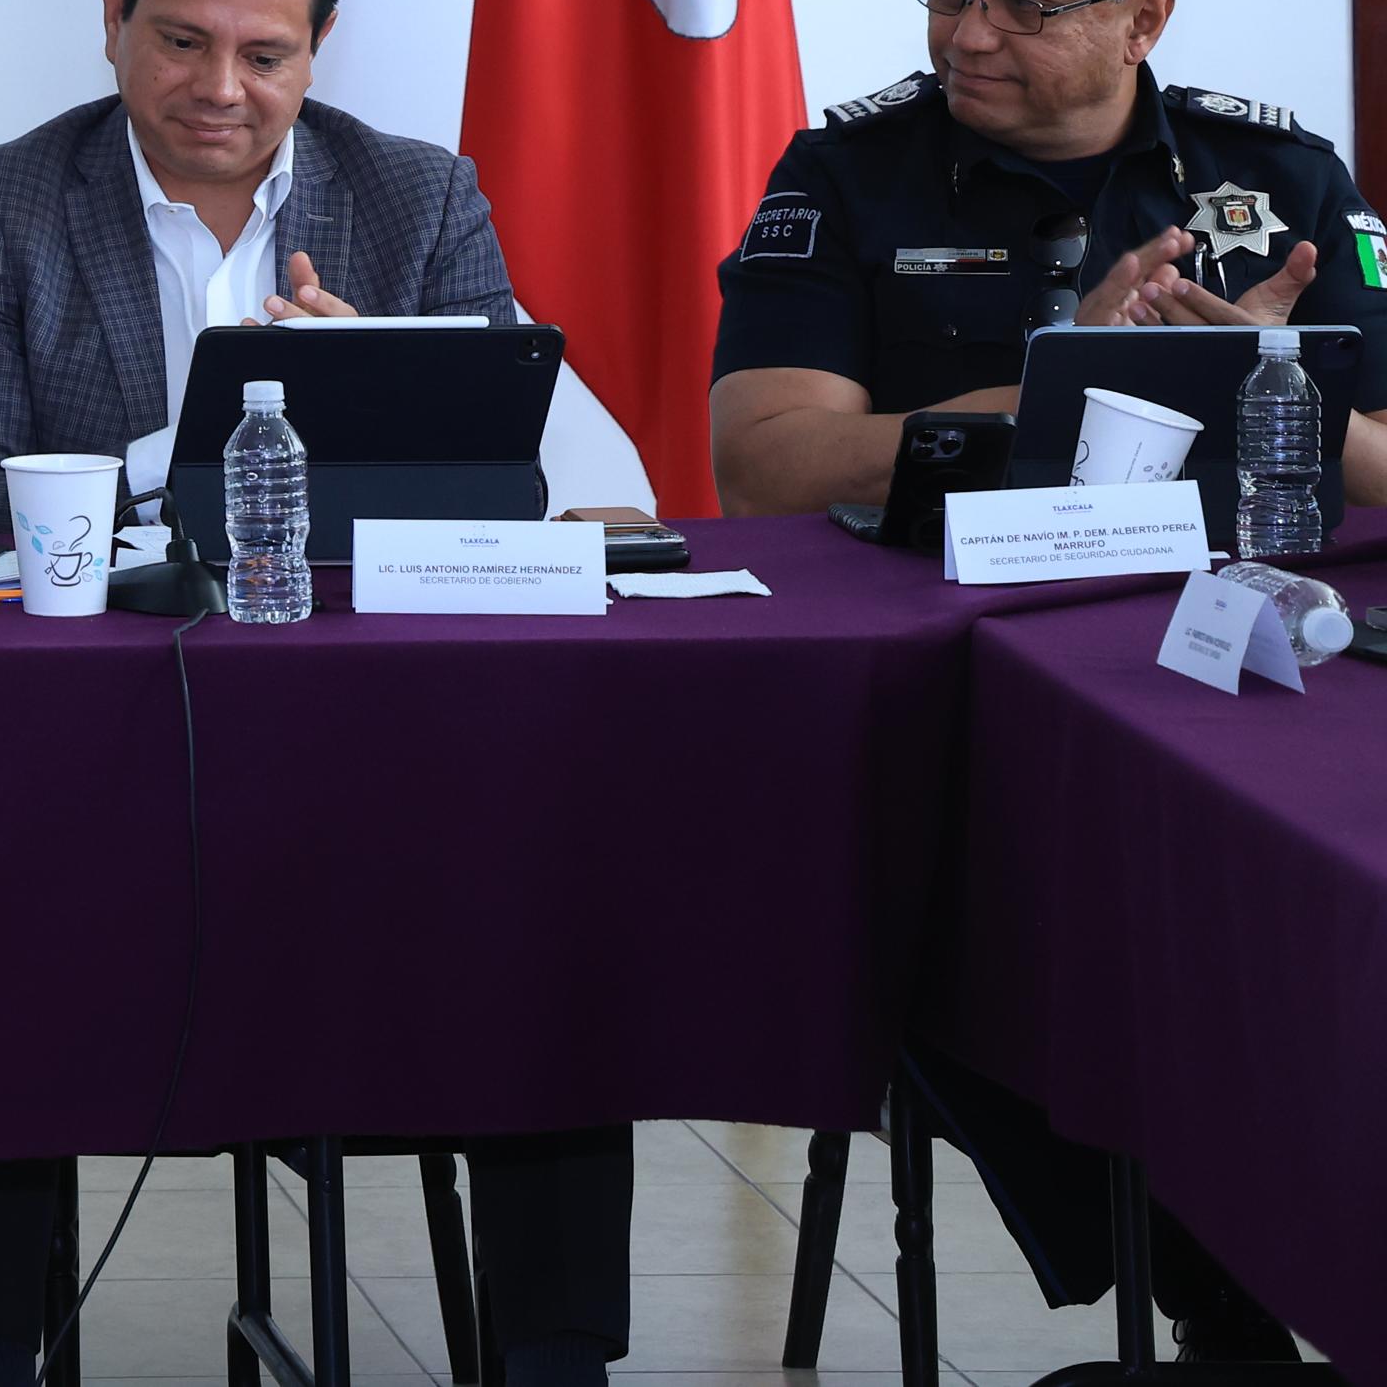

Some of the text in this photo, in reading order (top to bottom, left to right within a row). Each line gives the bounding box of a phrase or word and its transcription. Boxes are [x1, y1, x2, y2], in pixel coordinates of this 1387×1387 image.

[755, 208, 817, 225] SECRETARIO
[897, 262, 932, 271] POLICÍA
[1053, 504, 1093, 512] TLAXCALA
[961, 523, 1196, 545] CAPITÁN DE NAVÍO IM. P. DEM. ALBERTO PEREA
[1054, 540, 1106, 551] MARRUFO
[990, 547, 1173, 566] SECRETARIO DE SEGURIDAD CIUDADANA
[379, 563, 582, 574] LIC. LUIS ANTONIO RAMÍREZ HERNÁNDEZ
[419, 576, 542, 585] SECRETARIO DE GOBIERNO
